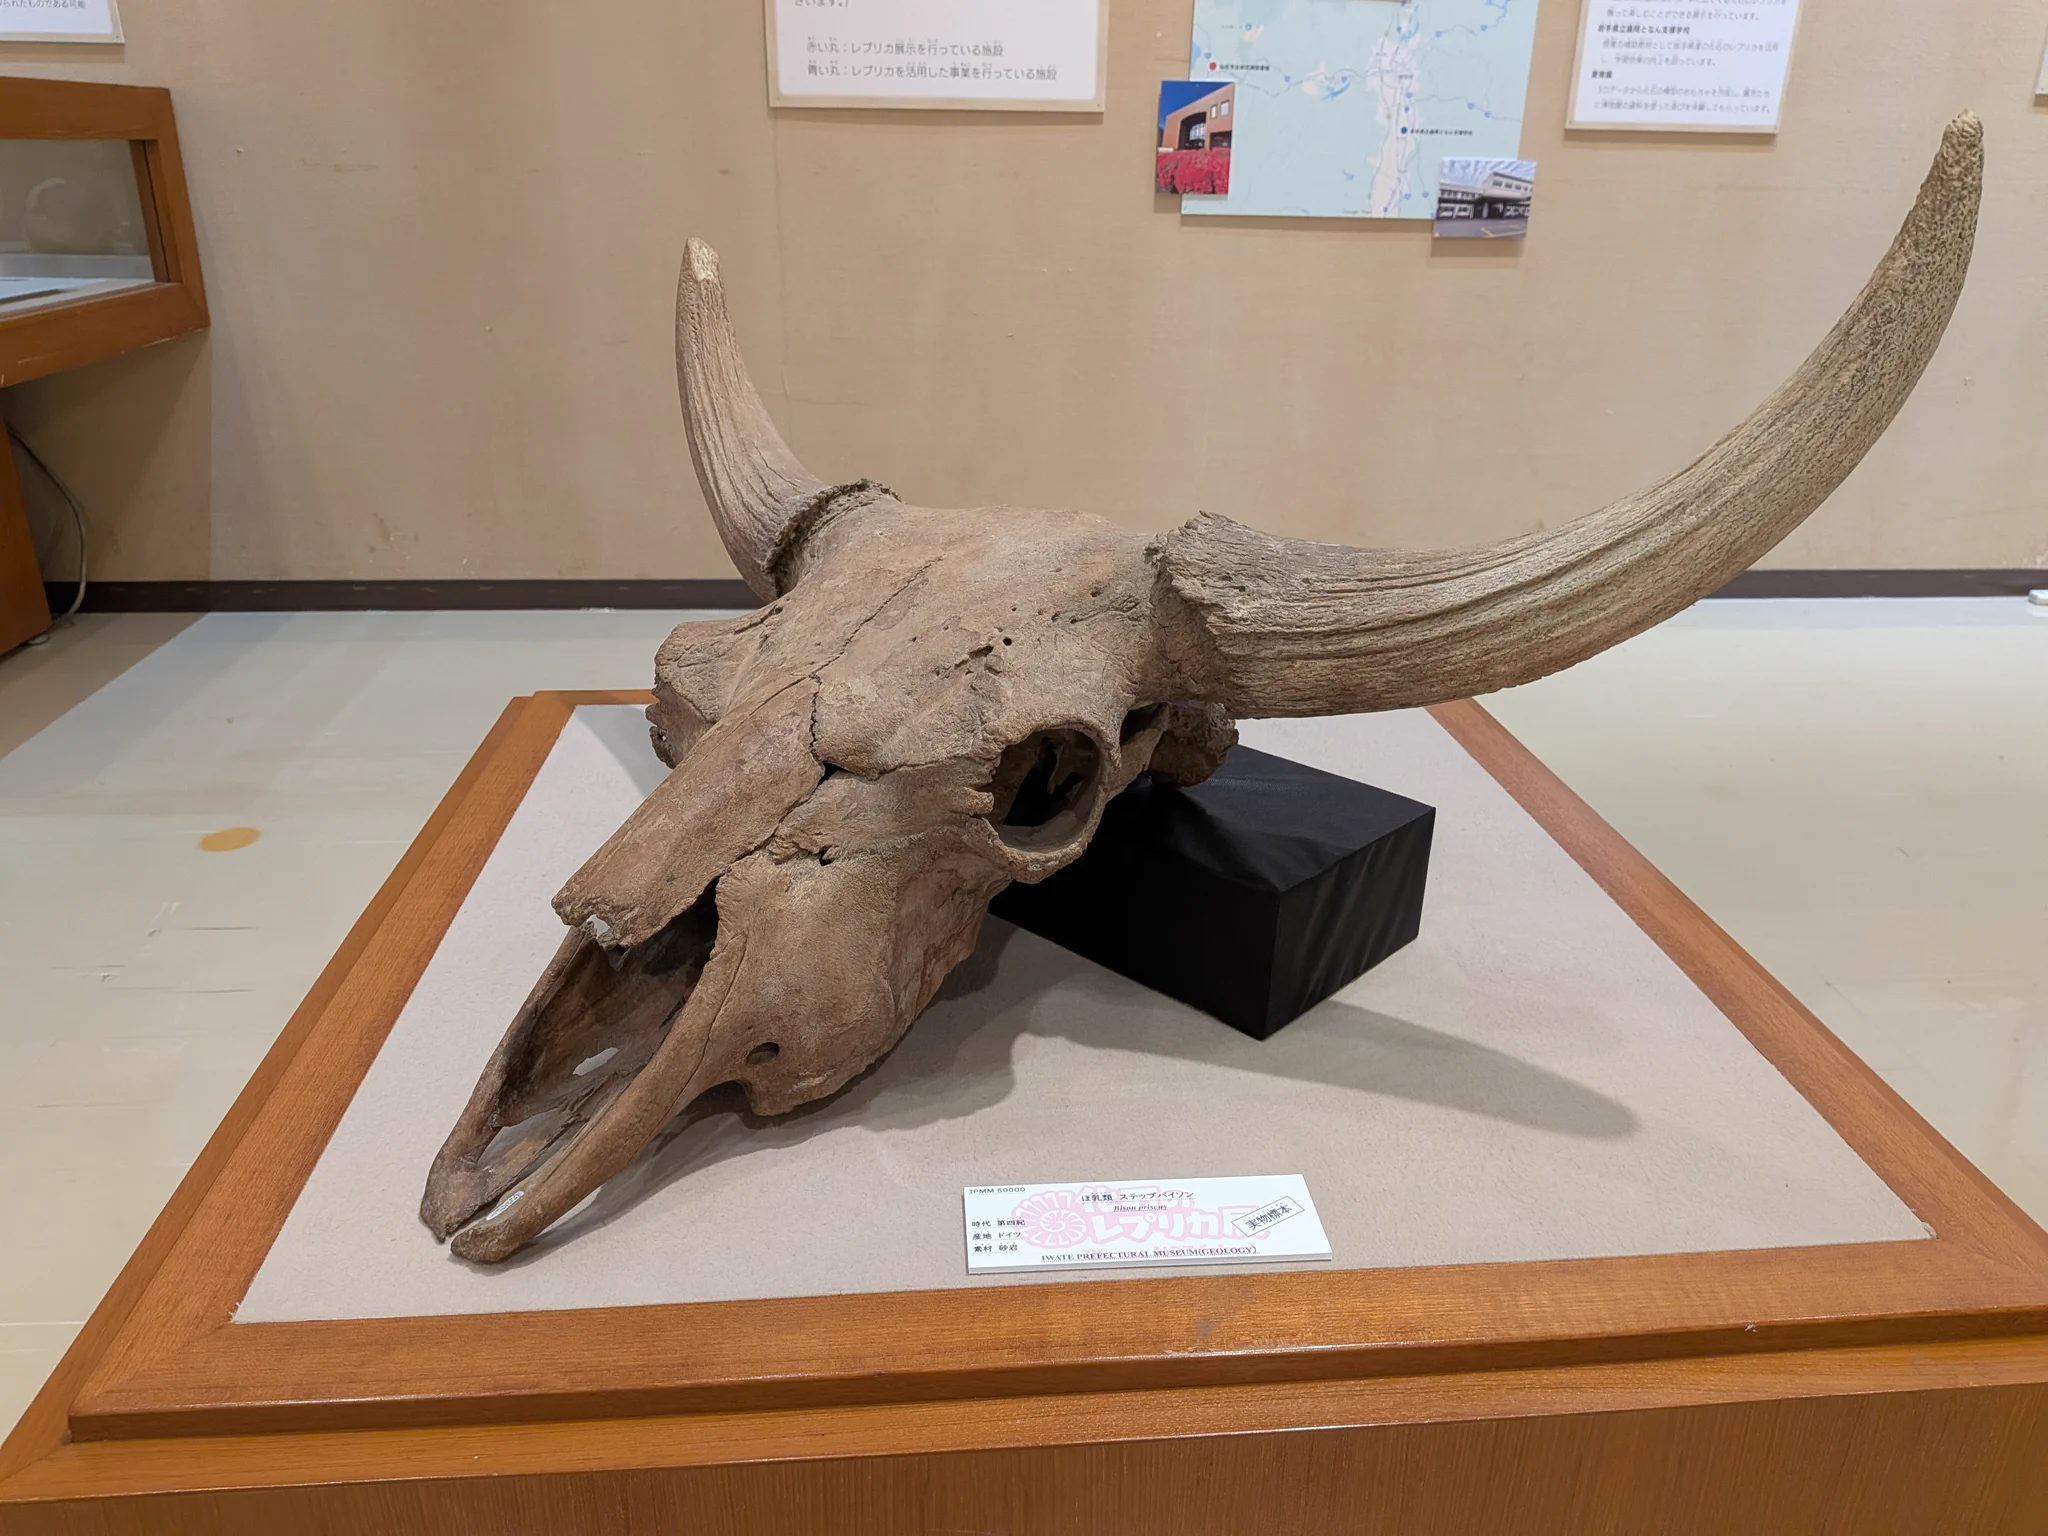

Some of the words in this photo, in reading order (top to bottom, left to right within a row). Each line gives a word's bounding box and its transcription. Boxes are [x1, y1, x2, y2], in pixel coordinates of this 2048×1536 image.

[969, 1187, 995, 1195] IPMM
[997, 1186, 1026, 1194] 50000
[1081, 1193, 1113, 1202] ほ乳類
[1119, 1191, 1194, 1201] ステップバイソン
[1138, 1204, 1167, 1213] priscus
[1245, 1203, 1293, 1231] 実物標本
[971, 1220, 992, 1228] 時代
[972, 1232, 993, 1240] 産地
[998, 1231, 1022, 1239] ドイツ
[973, 1245, 993, 1253] 素材
[998, 1244, 1018, 1252] 砂岩
[1041, 1254, 1074, 1262] IWATE
[1077, 1250, 1153, 1260] PREFECTURAL
[1153, 1245, 1257, 1257] MUSEUM(GEOLOGY)
